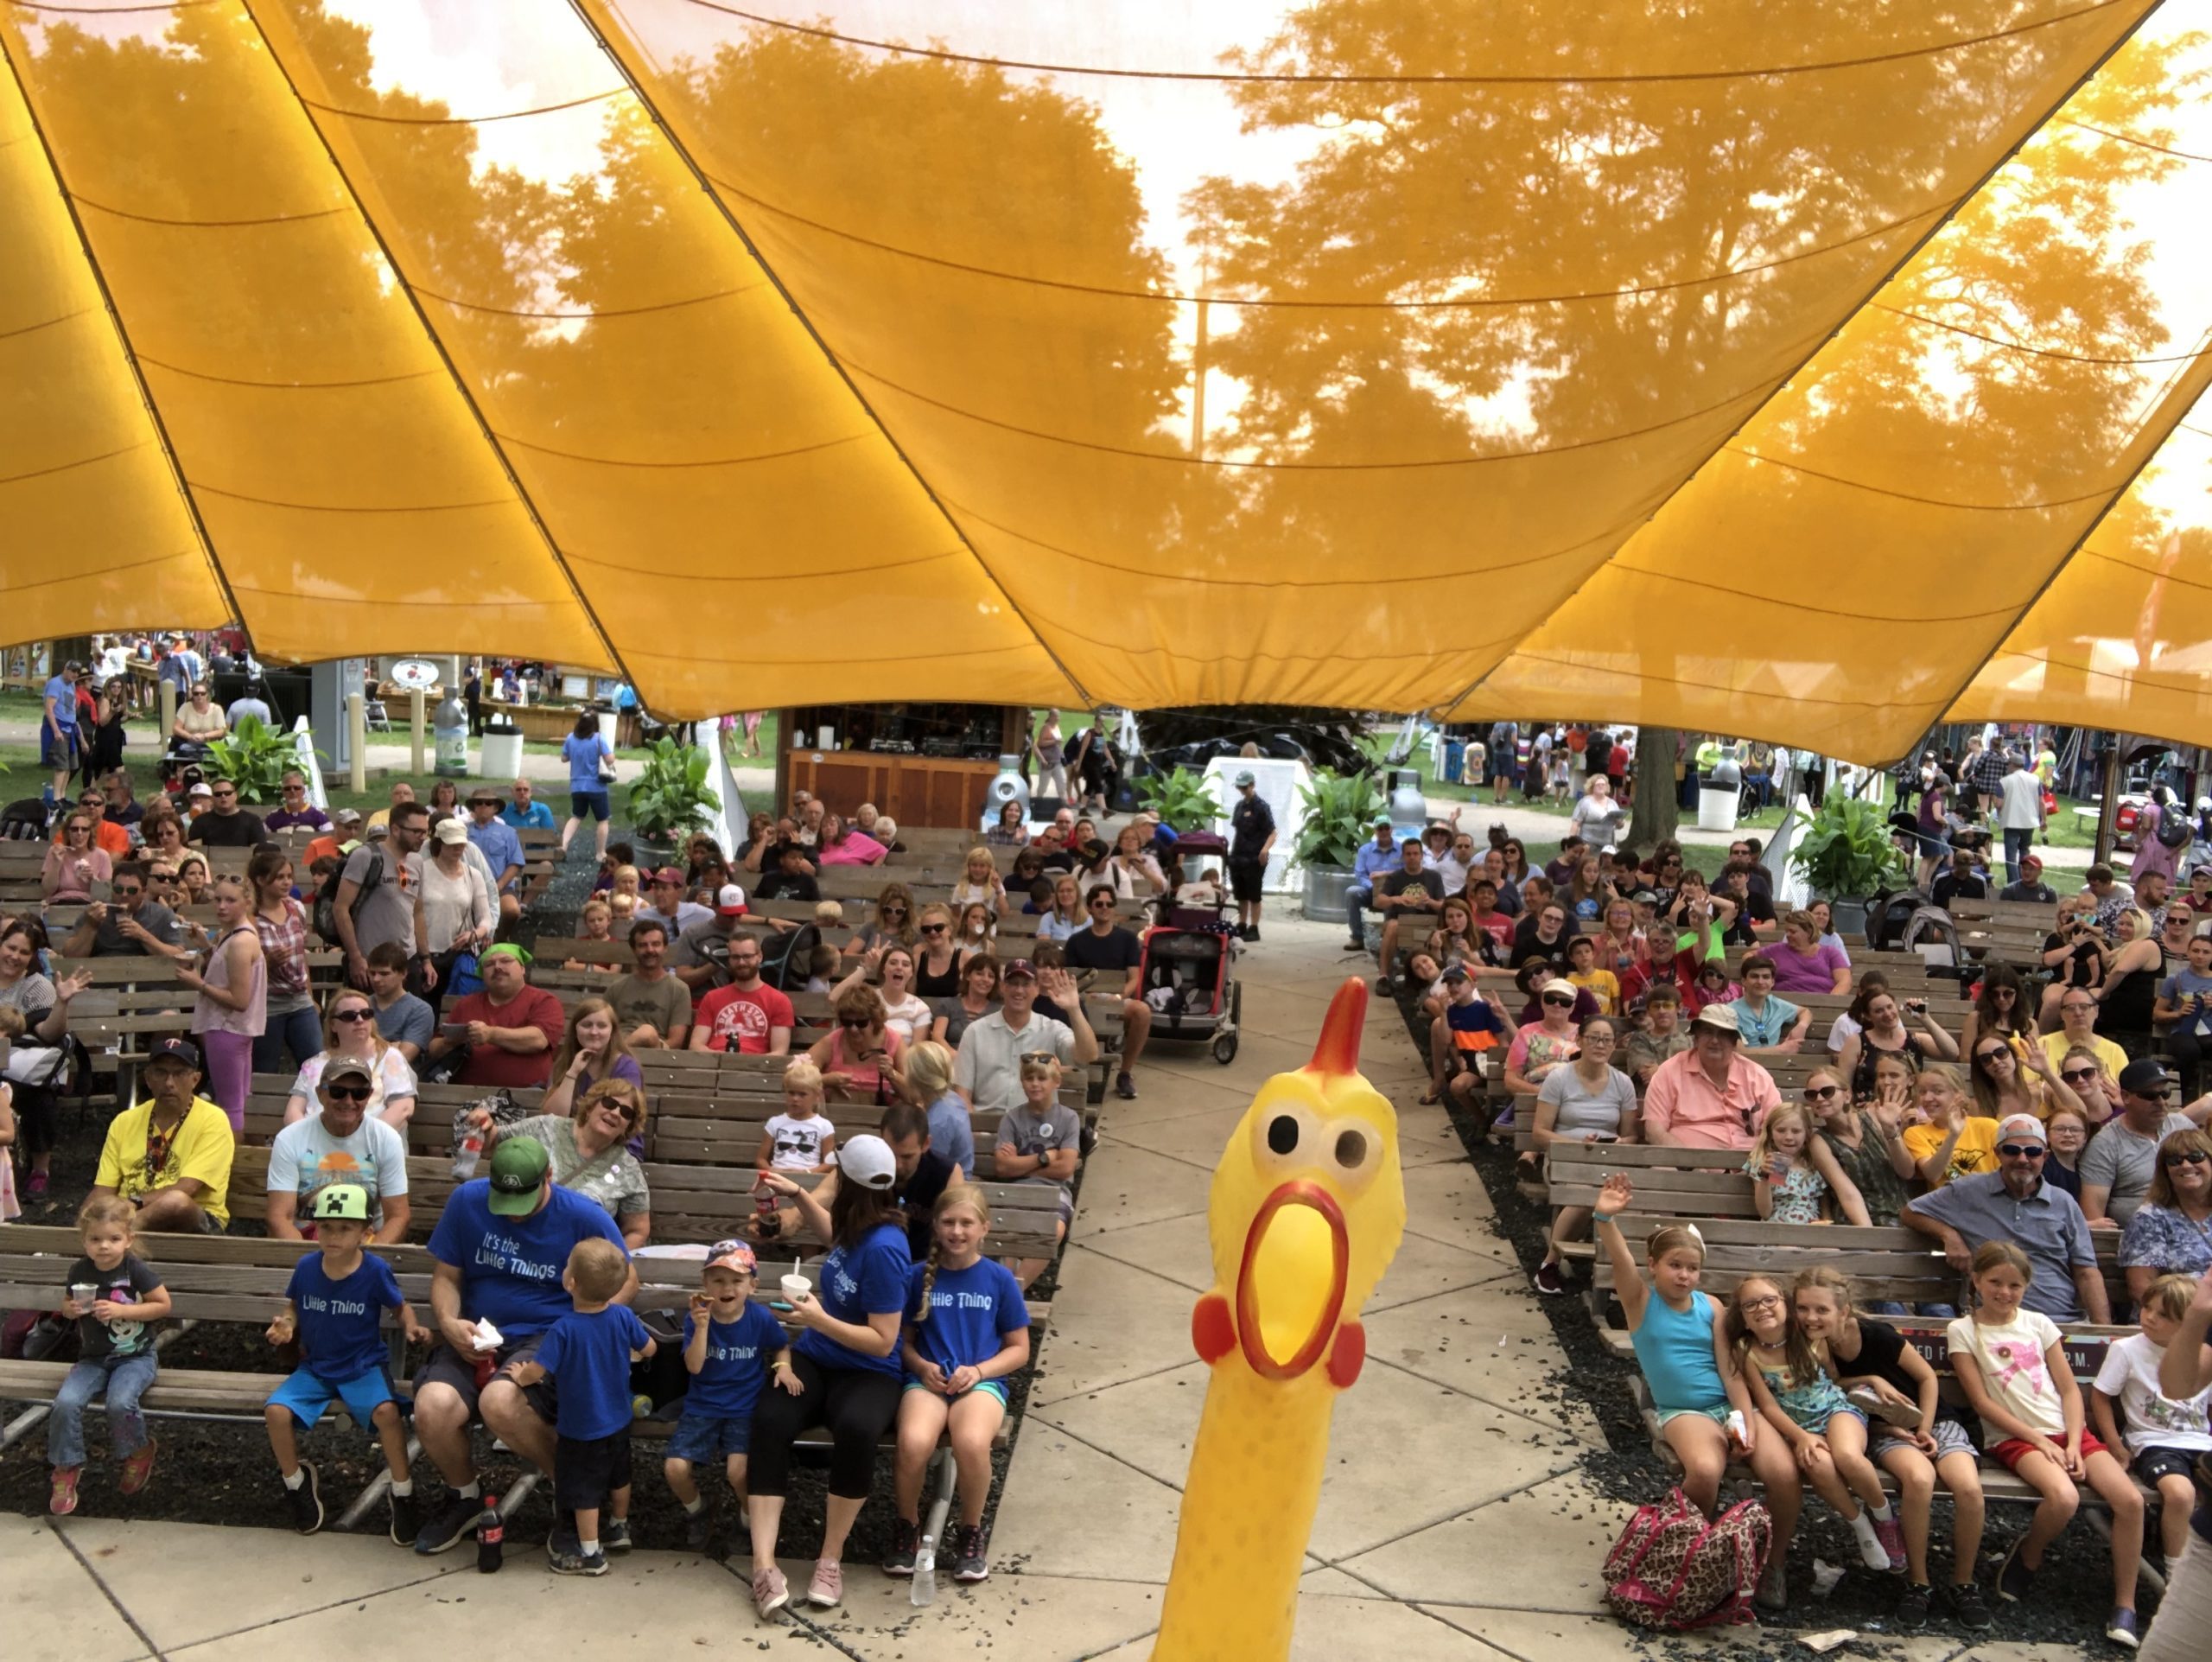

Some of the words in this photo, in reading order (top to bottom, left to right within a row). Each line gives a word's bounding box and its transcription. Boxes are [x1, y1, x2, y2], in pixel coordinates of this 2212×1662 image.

[717, 1003, 747, 1024] DEATH
[747, 1006, 766, 1027] STAR
[482, 1232, 501, 1251] It's
[501, 1236, 520, 1255] the
[475, 1247, 506, 1270] Little
[511, 1258, 556, 1280] Things
[302, 1295, 327, 1312] Little
[331, 1299, 365, 1315] Thing
[929, 1292, 954, 1307] ittle
[957, 1292, 993, 1311] Thing
[2063, 1352, 2091, 1367] P.M.
